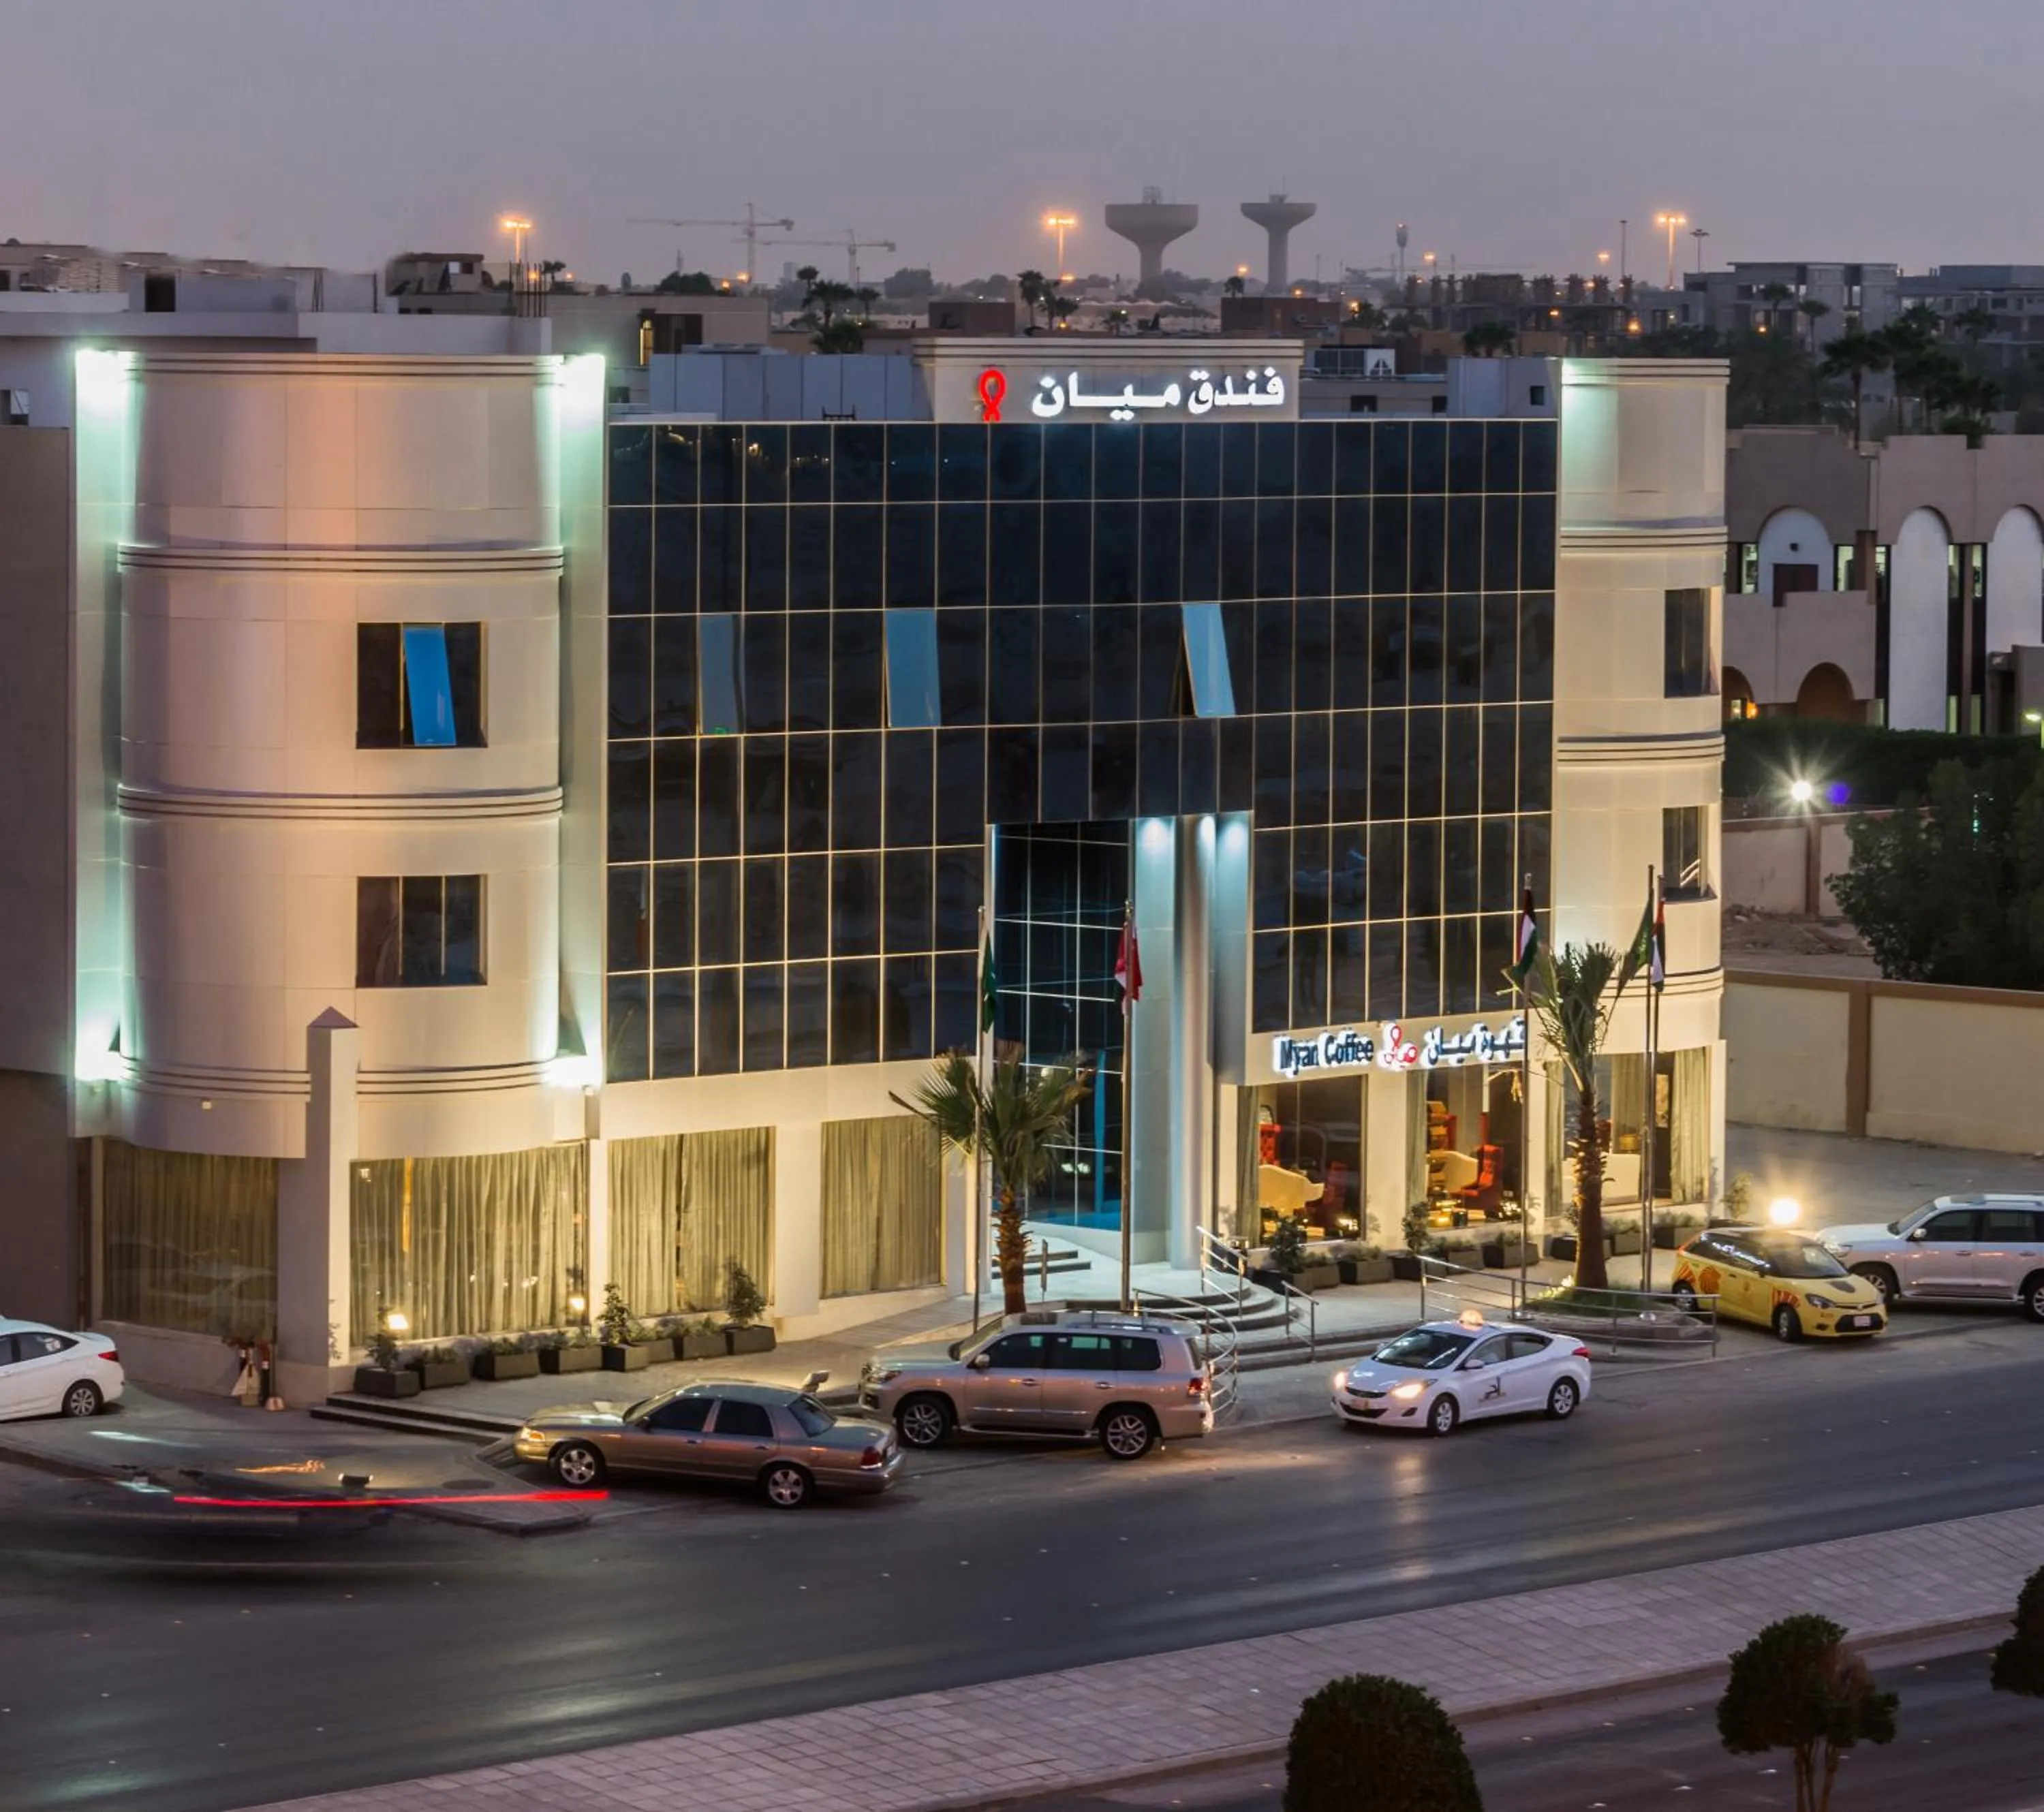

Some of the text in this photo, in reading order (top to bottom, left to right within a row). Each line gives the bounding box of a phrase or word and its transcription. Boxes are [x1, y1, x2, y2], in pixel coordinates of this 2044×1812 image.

[1032, 366, 1285, 421] فندق ميان
[1275, 1031, 1374, 1076] Myan Coffee
[1425, 1027, 1476, 1066] ميان
